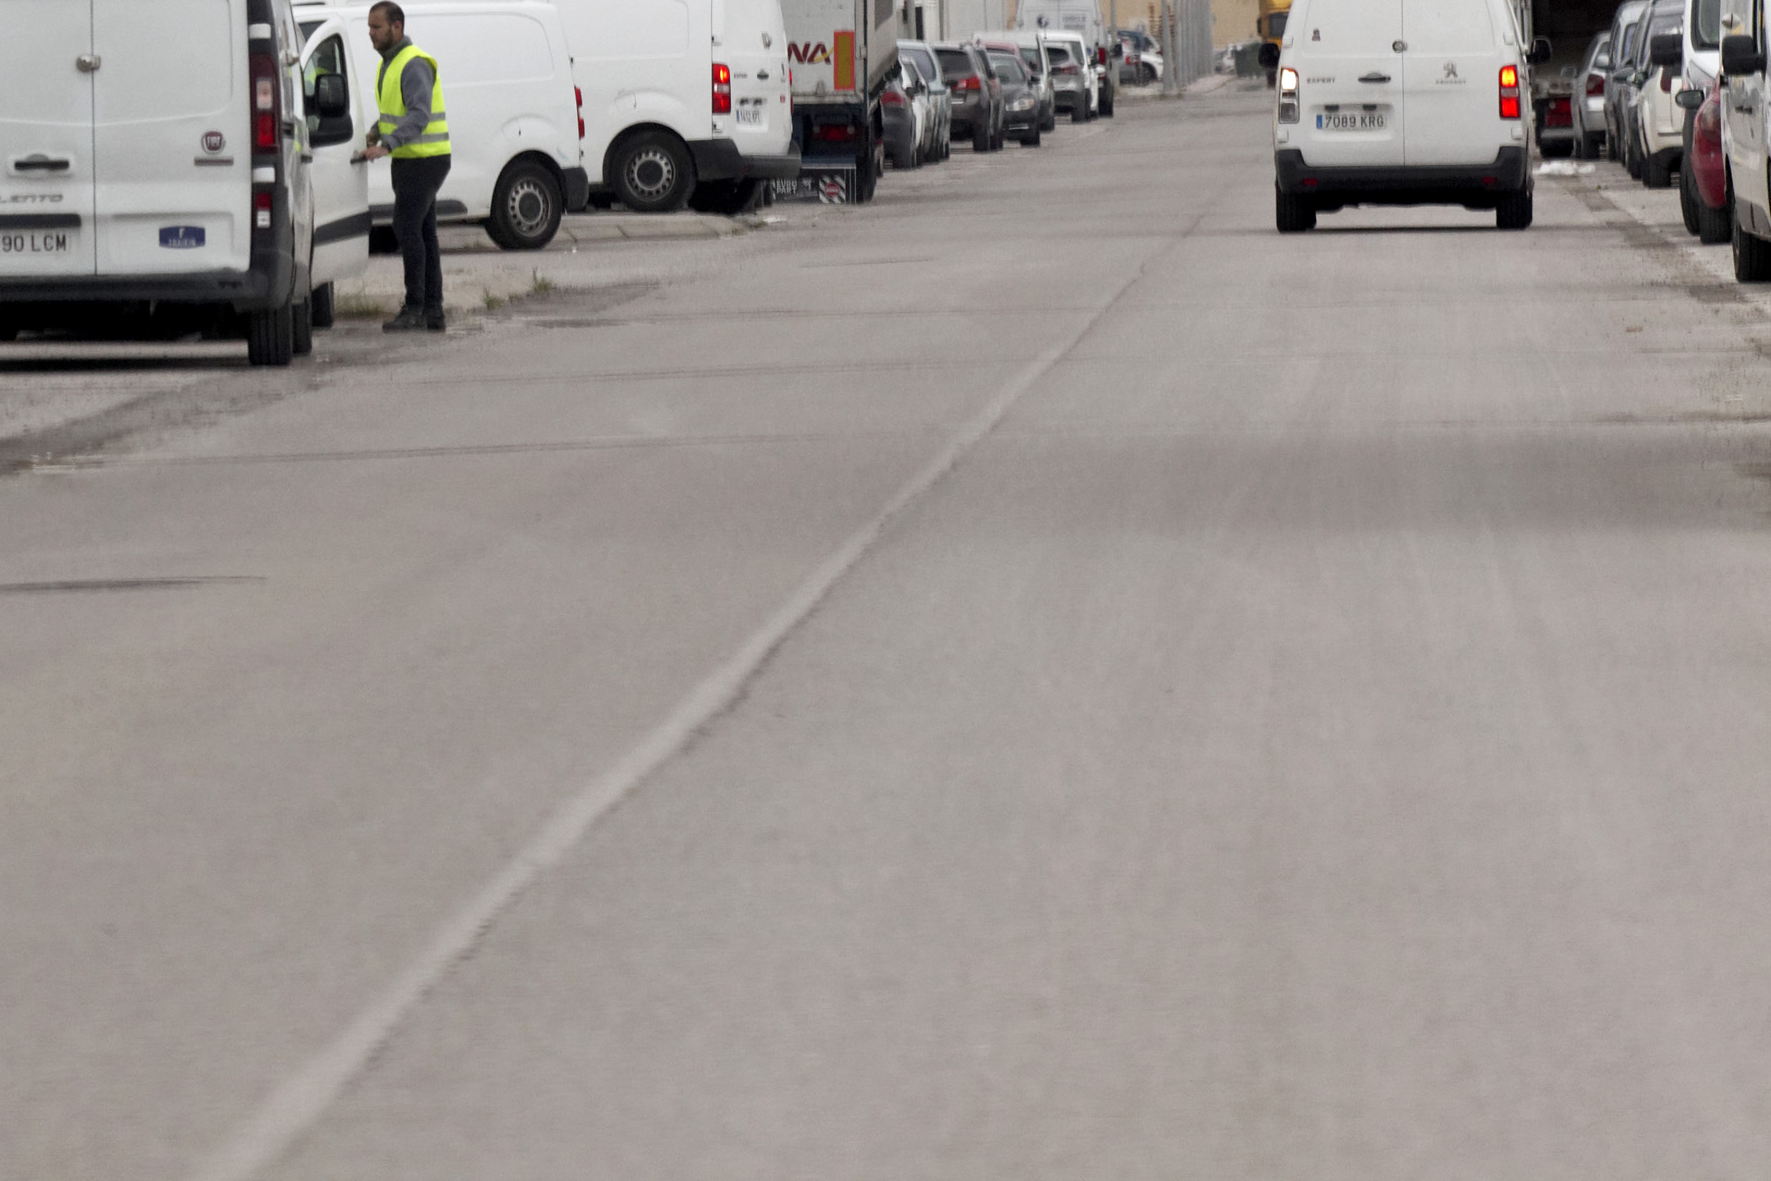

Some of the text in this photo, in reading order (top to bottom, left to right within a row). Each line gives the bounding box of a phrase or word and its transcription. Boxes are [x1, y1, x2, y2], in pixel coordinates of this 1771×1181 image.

[1325, 115, 1384, 128] 7089 KRG
[31, 234, 67, 252] LCM
